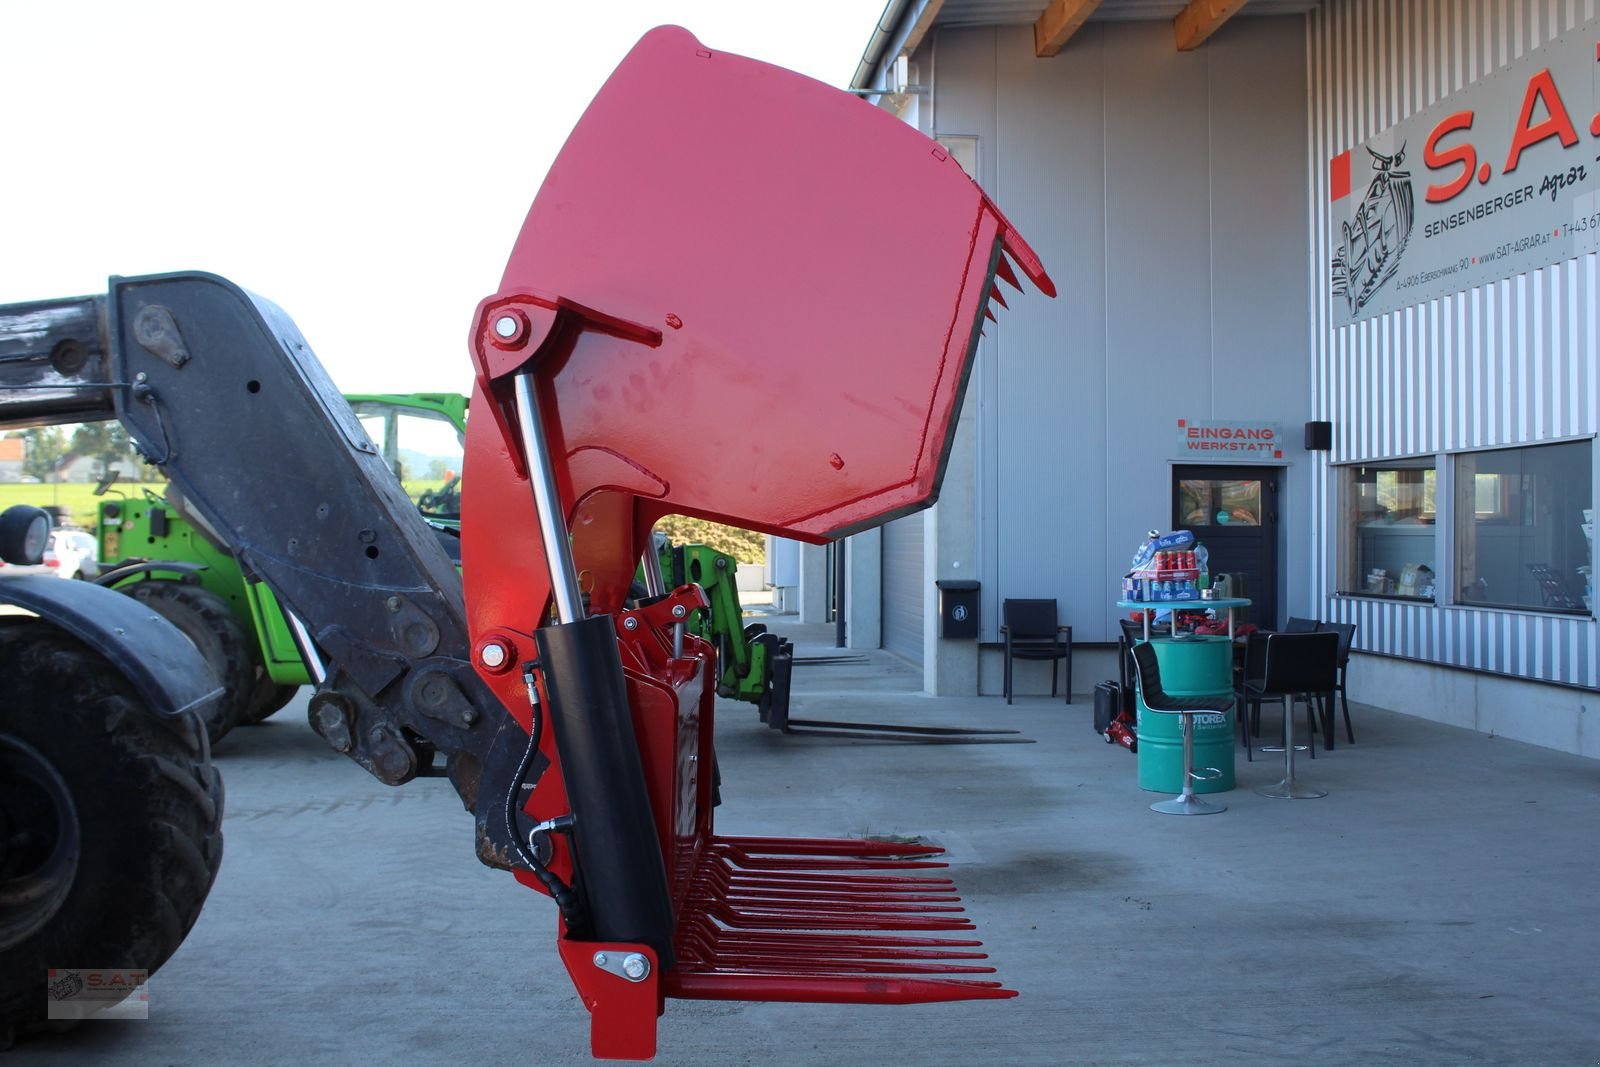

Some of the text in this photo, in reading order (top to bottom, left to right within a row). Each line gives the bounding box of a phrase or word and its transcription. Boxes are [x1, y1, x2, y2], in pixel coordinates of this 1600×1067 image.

[1424, 41, 1600, 204] S.A.
[1424, 165, 1587, 238] SENSENBERGER Agrar
[1459, 257, 1469, 270] 90
[1187, 428, 1274, 440] EINGANG
[1187, 441, 1274, 451] WERKSTATT
